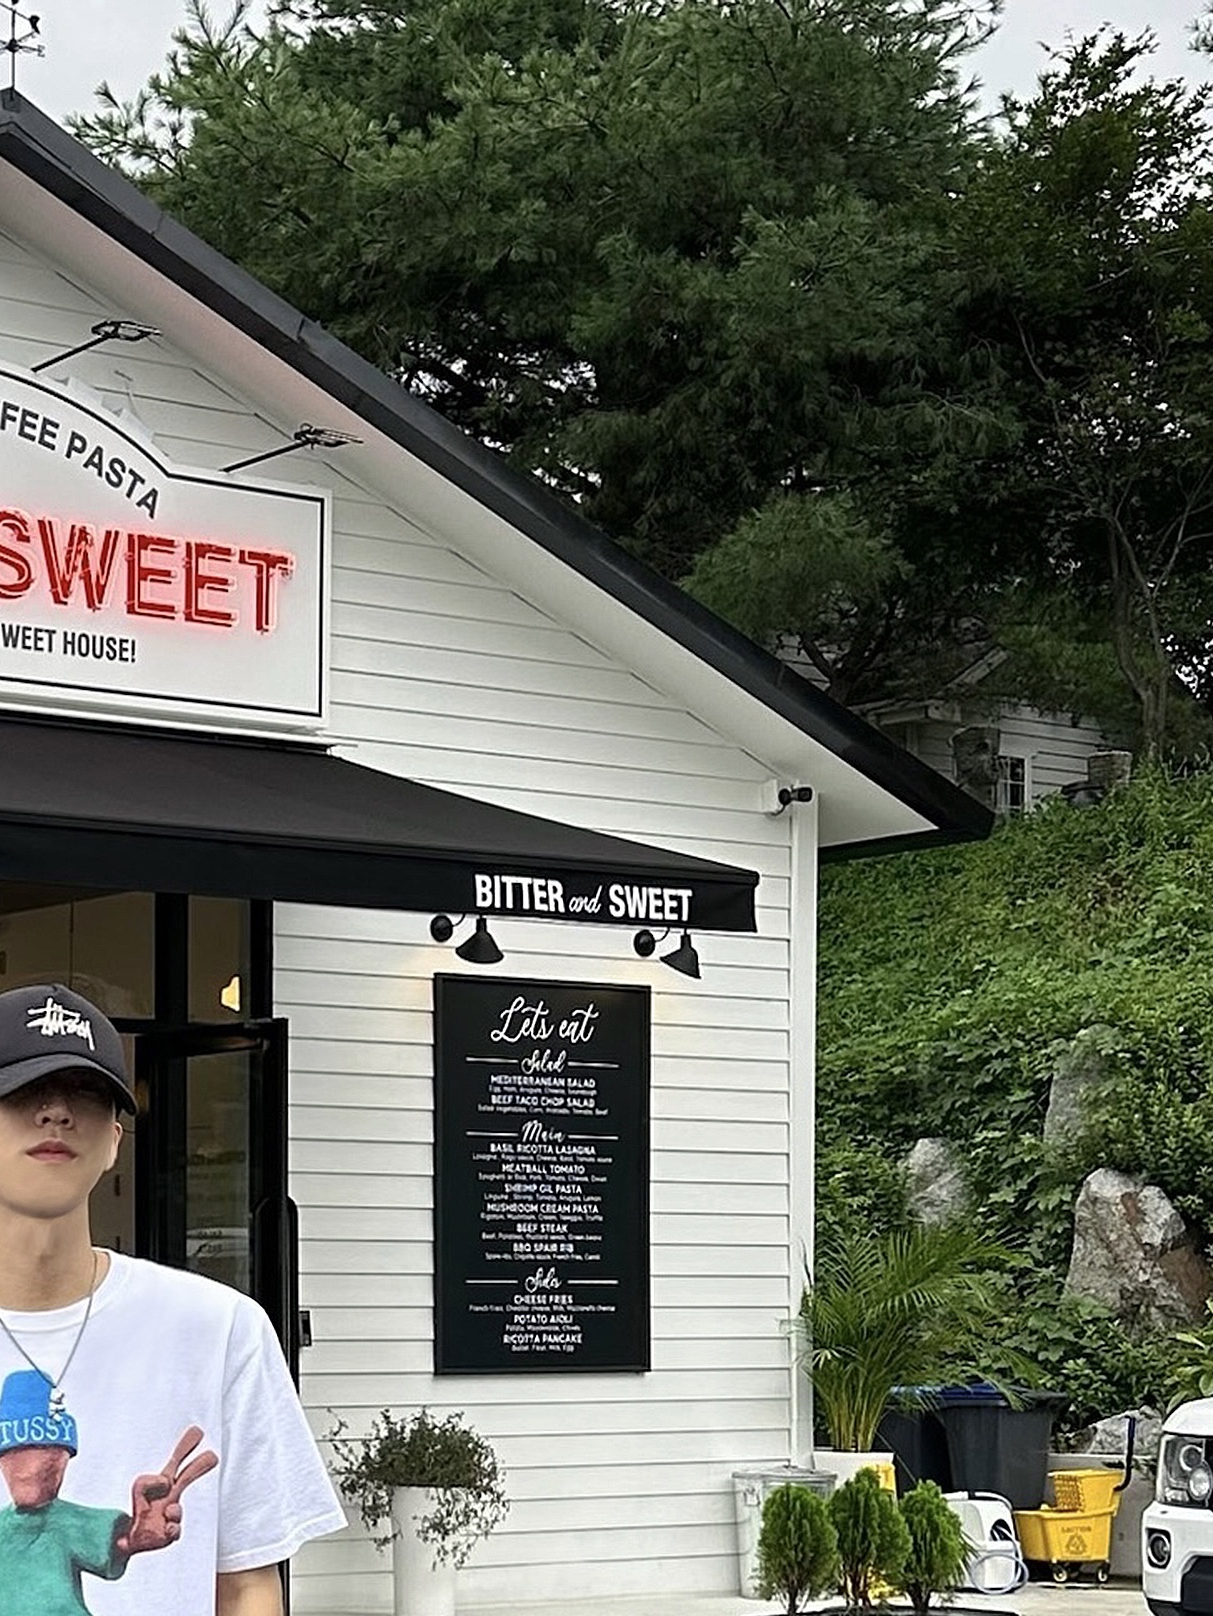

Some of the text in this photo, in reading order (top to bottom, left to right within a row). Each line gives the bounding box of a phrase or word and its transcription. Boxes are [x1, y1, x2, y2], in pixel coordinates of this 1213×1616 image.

[65, 430, 159, 520] PASTA
[63, 630, 137, 663] HOUSE!
[474, 873, 693, 922] BITTER and SWEET
[490, 995, 600, 1044] Lets eat
[520, 1048, 567, 1075] Salad
[490, 1074, 596, 1088] MEDITERRANEAN SALAD
[491, 1094, 513, 1105] BEEF
[515, 1095, 539, 1106] TACO
[567, 1096, 596, 1108] SALAD
[521, 1119, 567, 1143] Main
[490, 1143, 597, 1155] BASIL RICOTTA LASAGNA
[501, 1163, 586, 1175] MEATBALL TOMATO
[556, 1184, 583, 1195] PASTA
[486, 1202, 599, 1214] MUSHROOM CREAM PASTA
[516, 1223, 569, 1234] BEEF STEAK
[513, 1294, 574, 1305] CHEESE FRIES
[514, 1314, 548, 1325] POTATO
[502, 1333, 583, 1345] RICOTTA PANCAKE
